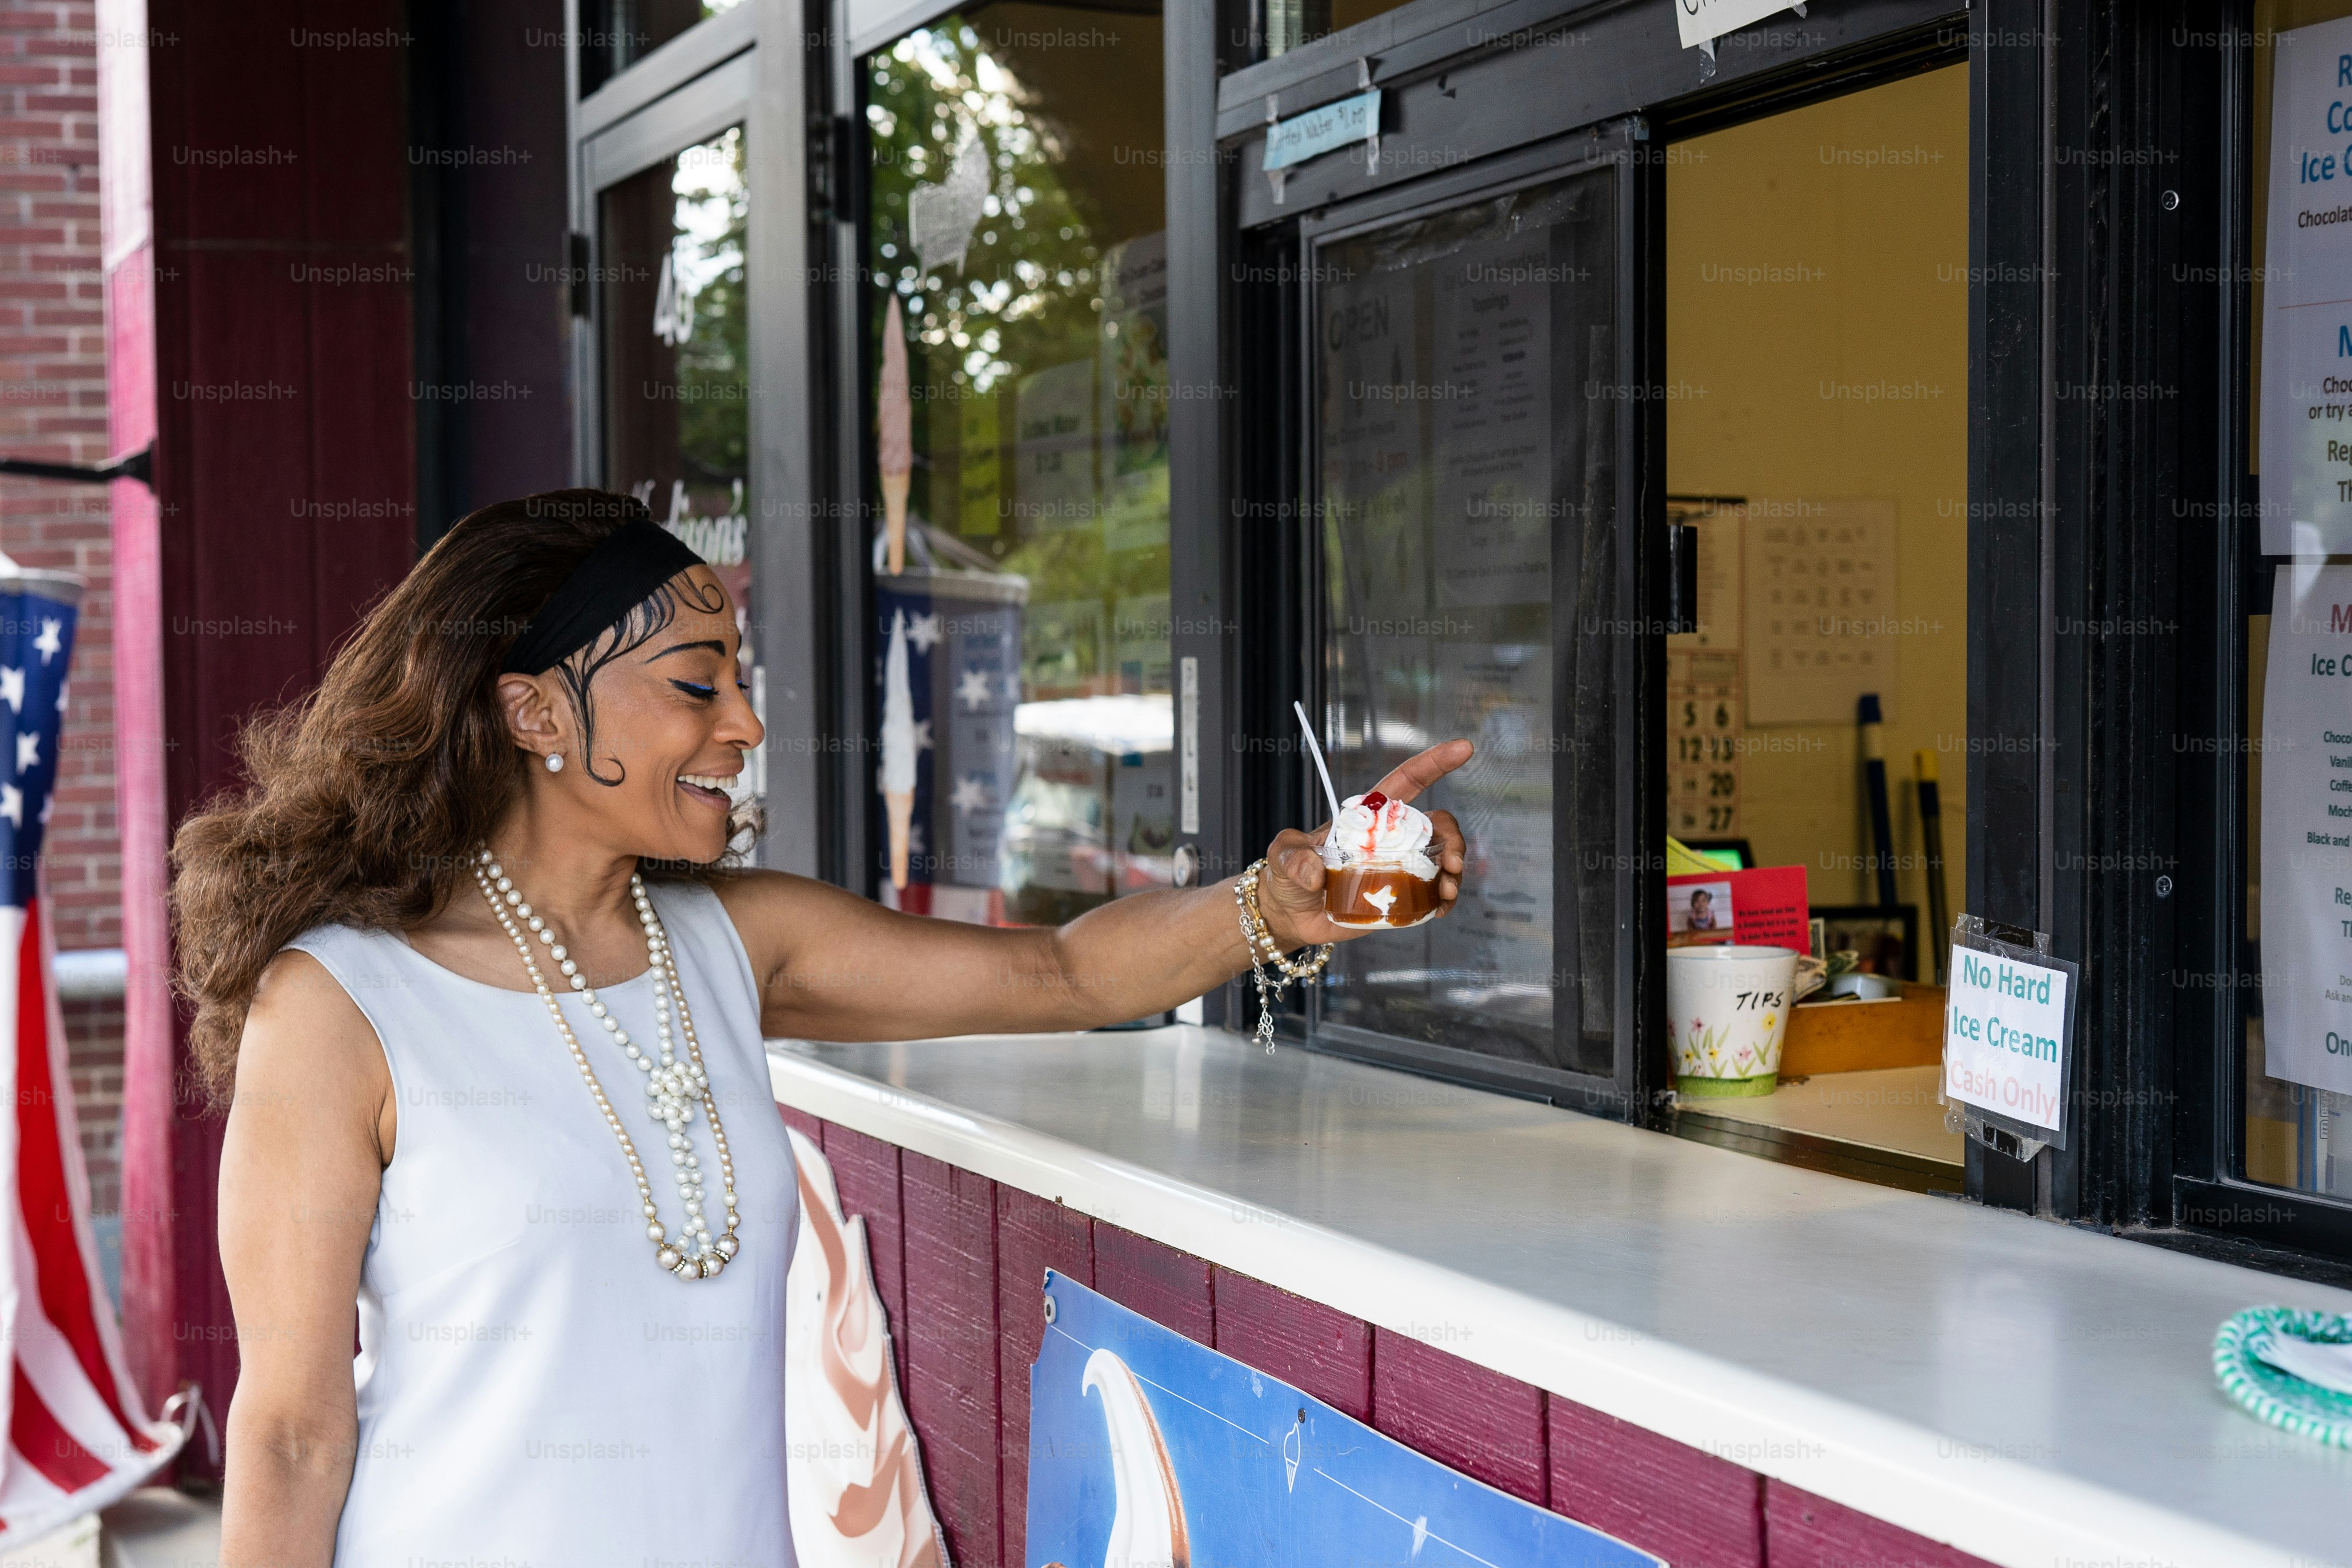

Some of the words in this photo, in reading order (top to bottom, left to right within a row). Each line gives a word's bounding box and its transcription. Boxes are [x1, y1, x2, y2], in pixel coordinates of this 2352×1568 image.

[2301, 152, 2336, 184] Ice
[1328, 295, 1389, 352] OPEN
[2308, 406, 2323, 420] or
[2326, 402, 2345, 422] try
[2311, 653, 2336, 677] Ice
[1684, 701, 1696, 728] 5
[1715, 703, 1729, 728] 6
[1679, 736, 1701, 763] 12
[1711, 736, 1733, 763] 13
[1709, 771, 1734, 797] 20
[1708, 806, 1733, 832] 27
[2307, 831, 2331, 845] Black
[2333, 835, 2350, 847] and
[1963, 954, 1992, 989] No
[1997, 964, 2051, 1005] Hard
[1736, 991, 1784, 1011] TIPS
[2325, 989, 2340, 1001] Ask
[1953, 1005, 1981, 1041] Ice
[1987, 1017, 2057, 1063] Cream
[1950, 1060, 1996, 1101] Cash
[2003, 1076, 2056, 1125] Only
